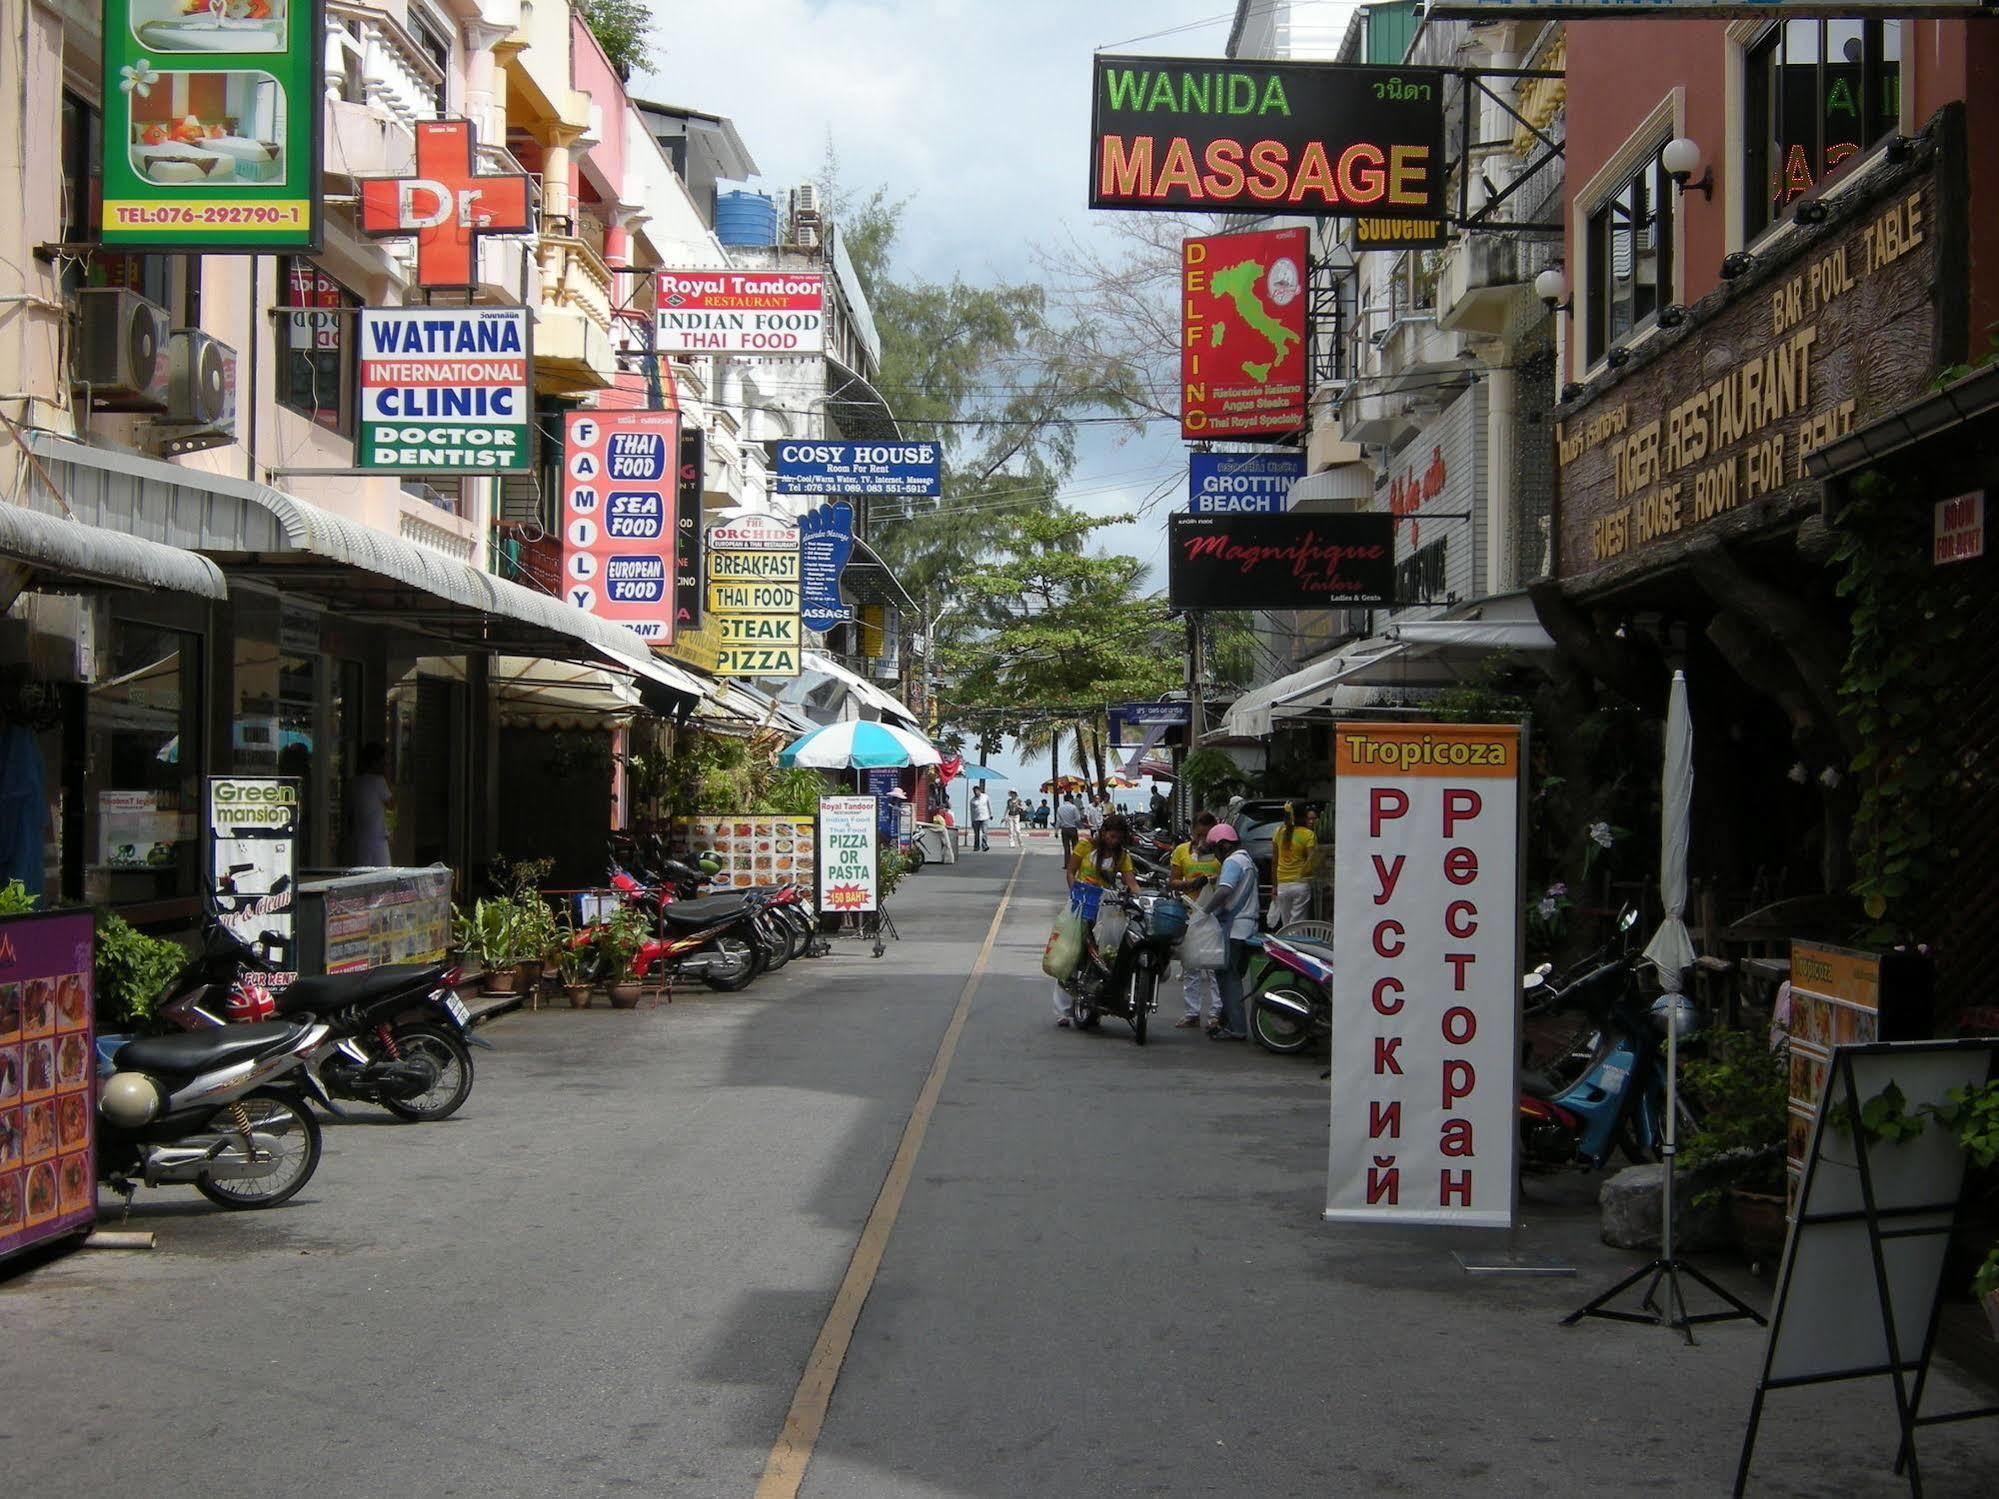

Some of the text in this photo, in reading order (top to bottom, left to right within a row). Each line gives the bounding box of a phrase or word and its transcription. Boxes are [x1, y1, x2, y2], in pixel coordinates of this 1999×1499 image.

[1106, 69, 1291, 117] WANIDA
[1373, 79, 1431, 102] วนิดา
[1102, 135, 1429, 205] MASSAGE
[399, 179, 491, 230] Dr.
[116, 207, 299, 224] TEL:076-292790-1
[1773, 191, 1925, 336] BAR POOL TABLE
[661, 276, 823, 298] Royal Tandoor
[704, 296, 790, 308] RESTAURANT
[660, 313, 820, 331] INDIAN FOOD
[371, 321, 521, 353] WATTANA
[681, 332, 798, 349] THAI FOOD
[1185, 244, 1208, 431] DELFINO
[369, 363, 522, 383] INTERNATIONAL
[376, 388, 513, 417] CLINIC
[1208, 417, 1230, 429] Thai
[1231, 416, 1258, 428] Royal
[1607, 418, 1661, 500] TIGER
[1666, 326, 1818, 473] RESTAURANT
[375, 428, 517, 446] DOCTOR
[614, 435, 658, 455] THAI
[375, 448, 517, 467] DENTIST
[782, 446, 935, 464] COSY HOUSE
[614, 459, 656, 479] FOOD
[827, 465, 889, 474] Room For Rent
[612, 497, 658, 514] SEA
[1199, 496, 1271, 512] BEACH
[1593, 506, 1632, 560] GUEST
[1637, 482, 1682, 544] HOUSE
[1695, 456, 1738, 522] ROOM
[1748, 437, 1785, 500] FOR
[573, 424, 594, 608] FAMILY
[612, 518, 657, 536] FOOD
[715, 530, 796, 540] ORCHIDS
[1184, 531, 1385, 577] Magnifique
[609, 561, 661, 579] EUROPEAN
[715, 556, 796, 575] BREAKFAST
[615, 582, 658, 599] FOOD
[717, 588, 793, 607] THAI FOOD
[802, 608, 850, 619] ASSAGE
[721, 619, 792, 638] STEAK
[717, 651, 794, 670] PIZZA
[1345, 735, 1507, 771] Tropicoza
[215, 782, 296, 802] Green
[217, 805, 291, 823] mansion
[821, 802, 874, 812] Royal Tandoor
[829, 834, 868, 849] PIZZA
[840, 850, 858, 864] OR
[828, 866, 870, 879] PASTA
[846, 892, 866, 903] BAHT
[269, 972, 298, 986] RENT
[1366, 787, 1410, 1206] Русский
[1438, 787, 1483, 1207] Ресторан
